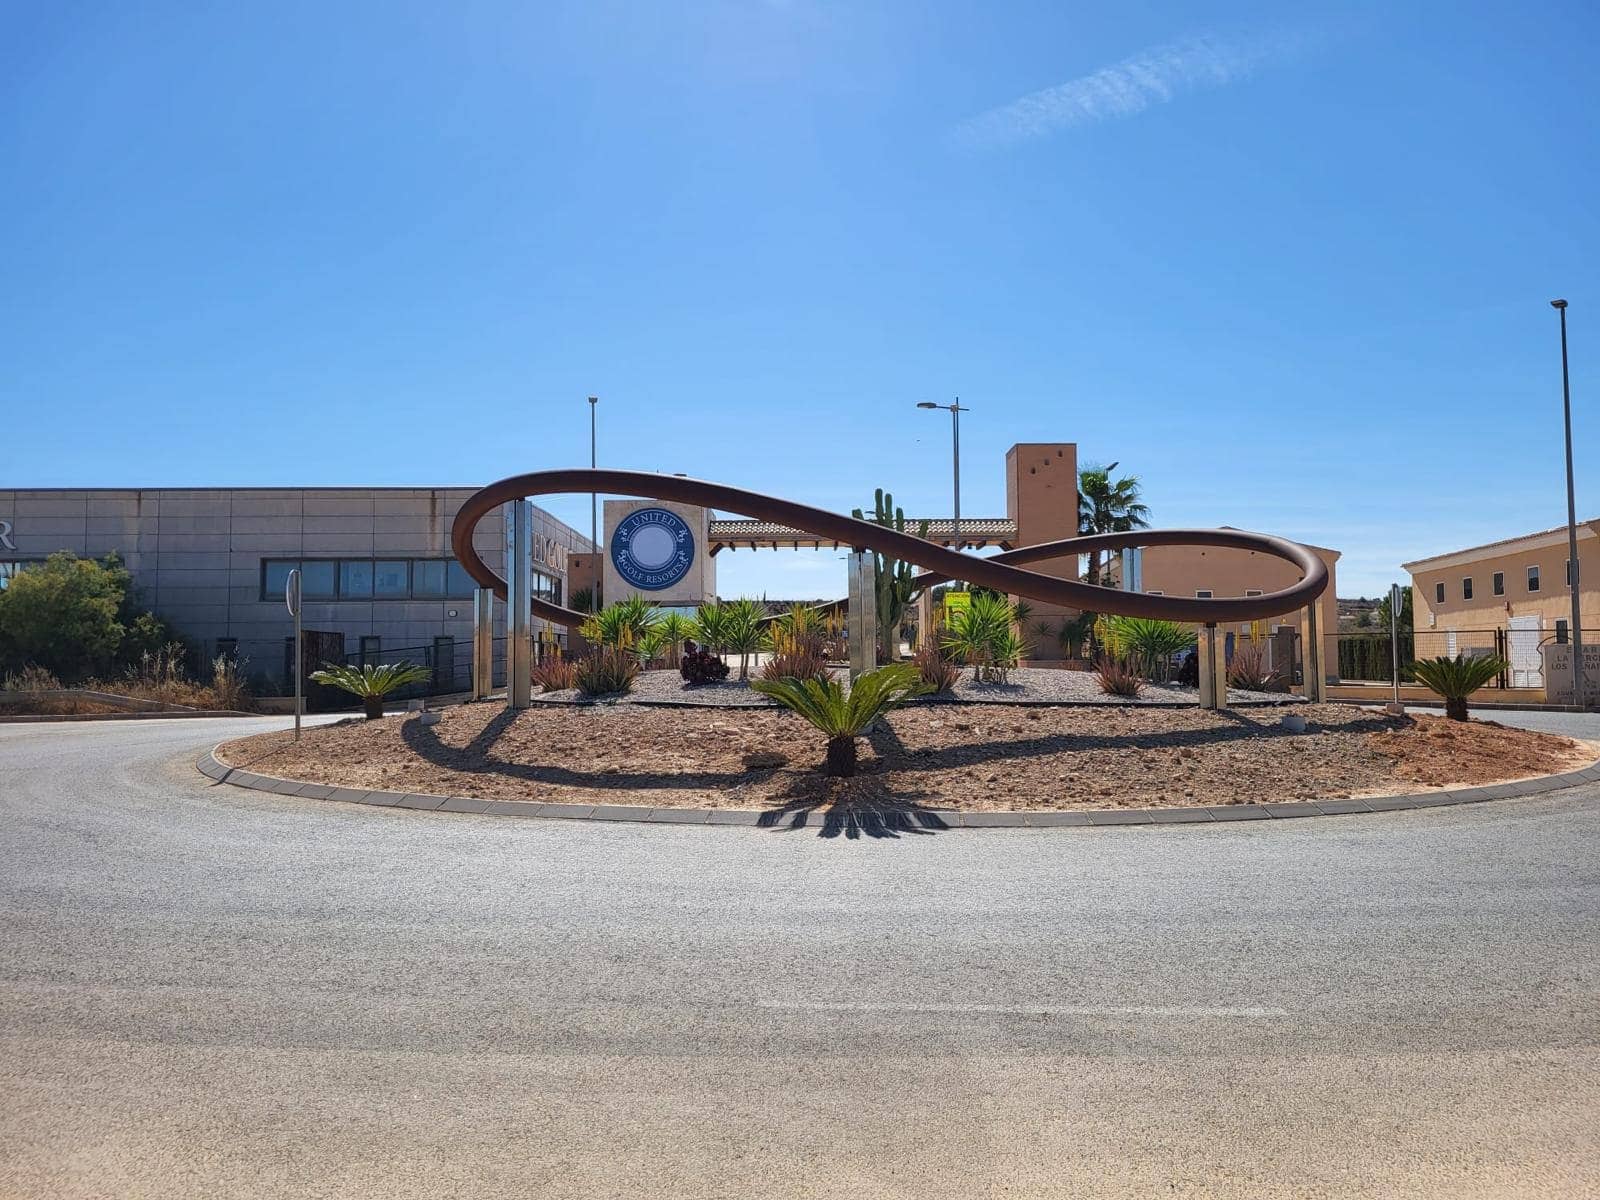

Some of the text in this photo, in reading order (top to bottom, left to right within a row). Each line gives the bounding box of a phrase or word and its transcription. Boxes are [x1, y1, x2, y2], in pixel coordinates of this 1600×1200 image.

[631, 512, 676, 526] UNITED
[0, 521, 17, 550] R
[622, 560, 687, 583] GOLF RESORTS
